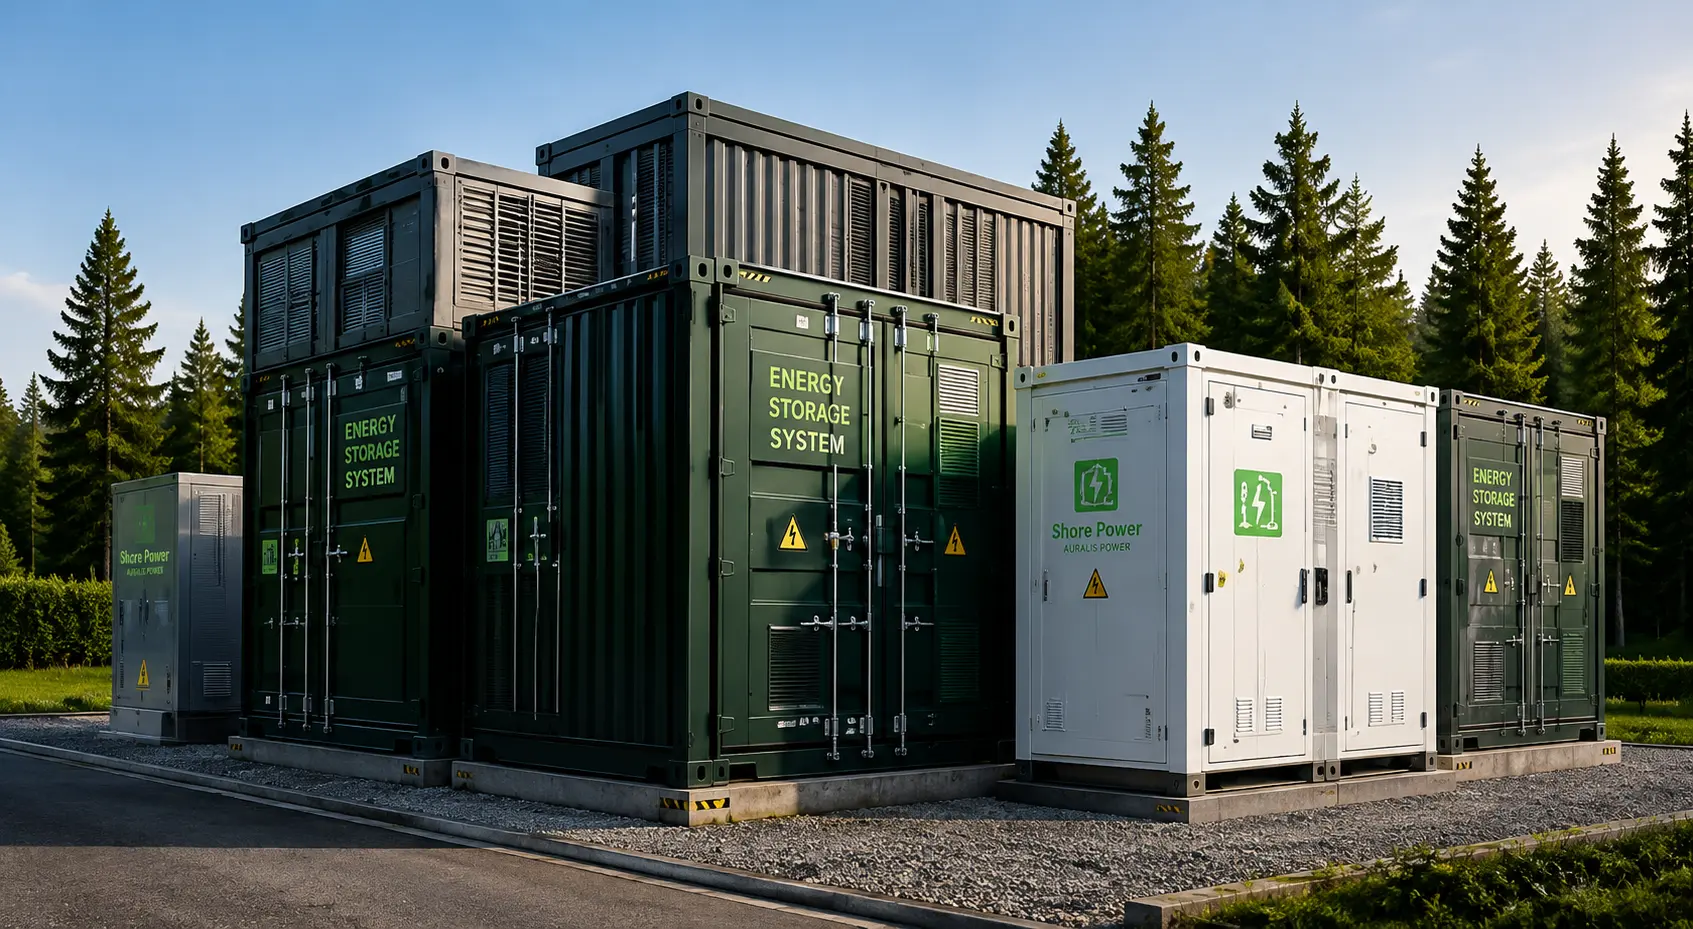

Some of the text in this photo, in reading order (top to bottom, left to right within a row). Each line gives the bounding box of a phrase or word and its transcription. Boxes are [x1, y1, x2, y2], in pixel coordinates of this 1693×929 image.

[769, 366, 844, 396] ENERGY
[769, 397, 850, 425] STORAGE
[345, 414, 396, 440] ENERGY
[345, 439, 400, 464] STORAGE
[770, 427, 844, 455] SYSTEM
[345, 466, 395, 489] SYSTEM
[1473, 467, 1513, 487] ENERGY
[1473, 489, 1515, 507] STORAGE
[1474, 510, 1512, 529] SYSTEM
[1052, 522, 1143, 540] Shore Power
[144, 549, 170, 563] Power
[1063, 542, 1131, 553] AURALIS POWER
